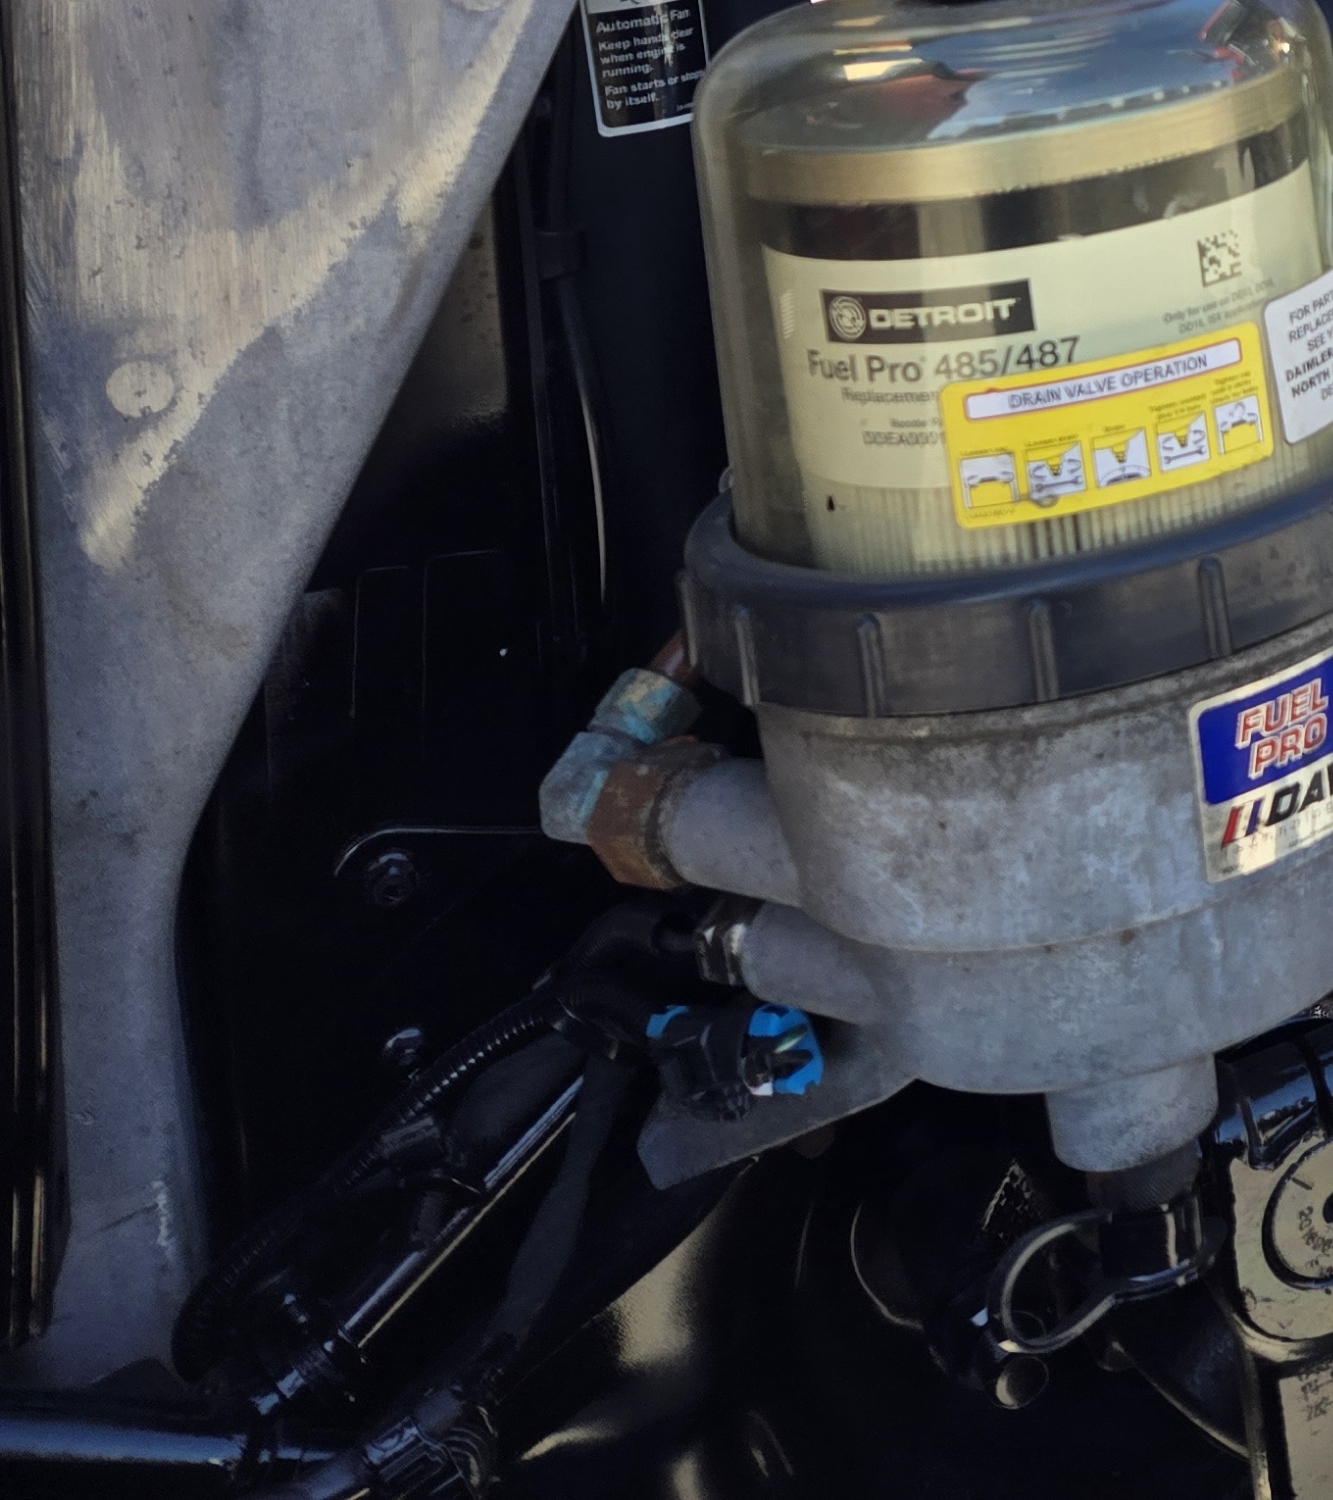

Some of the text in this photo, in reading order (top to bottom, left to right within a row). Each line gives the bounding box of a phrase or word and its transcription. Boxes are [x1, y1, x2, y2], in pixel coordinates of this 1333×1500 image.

[596, 8, 692, 34] Automatic Fan
[599, 36, 632, 52] Keep
[600, 52, 635, 64] when
[605, 83, 629, 96] Fan
[630, 77, 665, 91] starts
[667, 75, 680, 84] or
[606, 98, 622, 111] by
[867, 297, 1018, 331] DETROIT
[1288, 306, 1312, 324] FOR
[1307, 334, 1328, 353] SEE
[806, 348, 860, 384] Fuel
[934, 334, 1081, 380] 485/487
[1006, 352, 1210, 410] DRAIN VALVE OPERATION
[1290, 368, 1332, 399] NORTH
[1234, 677, 1330, 750] FUEL
[1247, 712, 1329, 781] PRO
